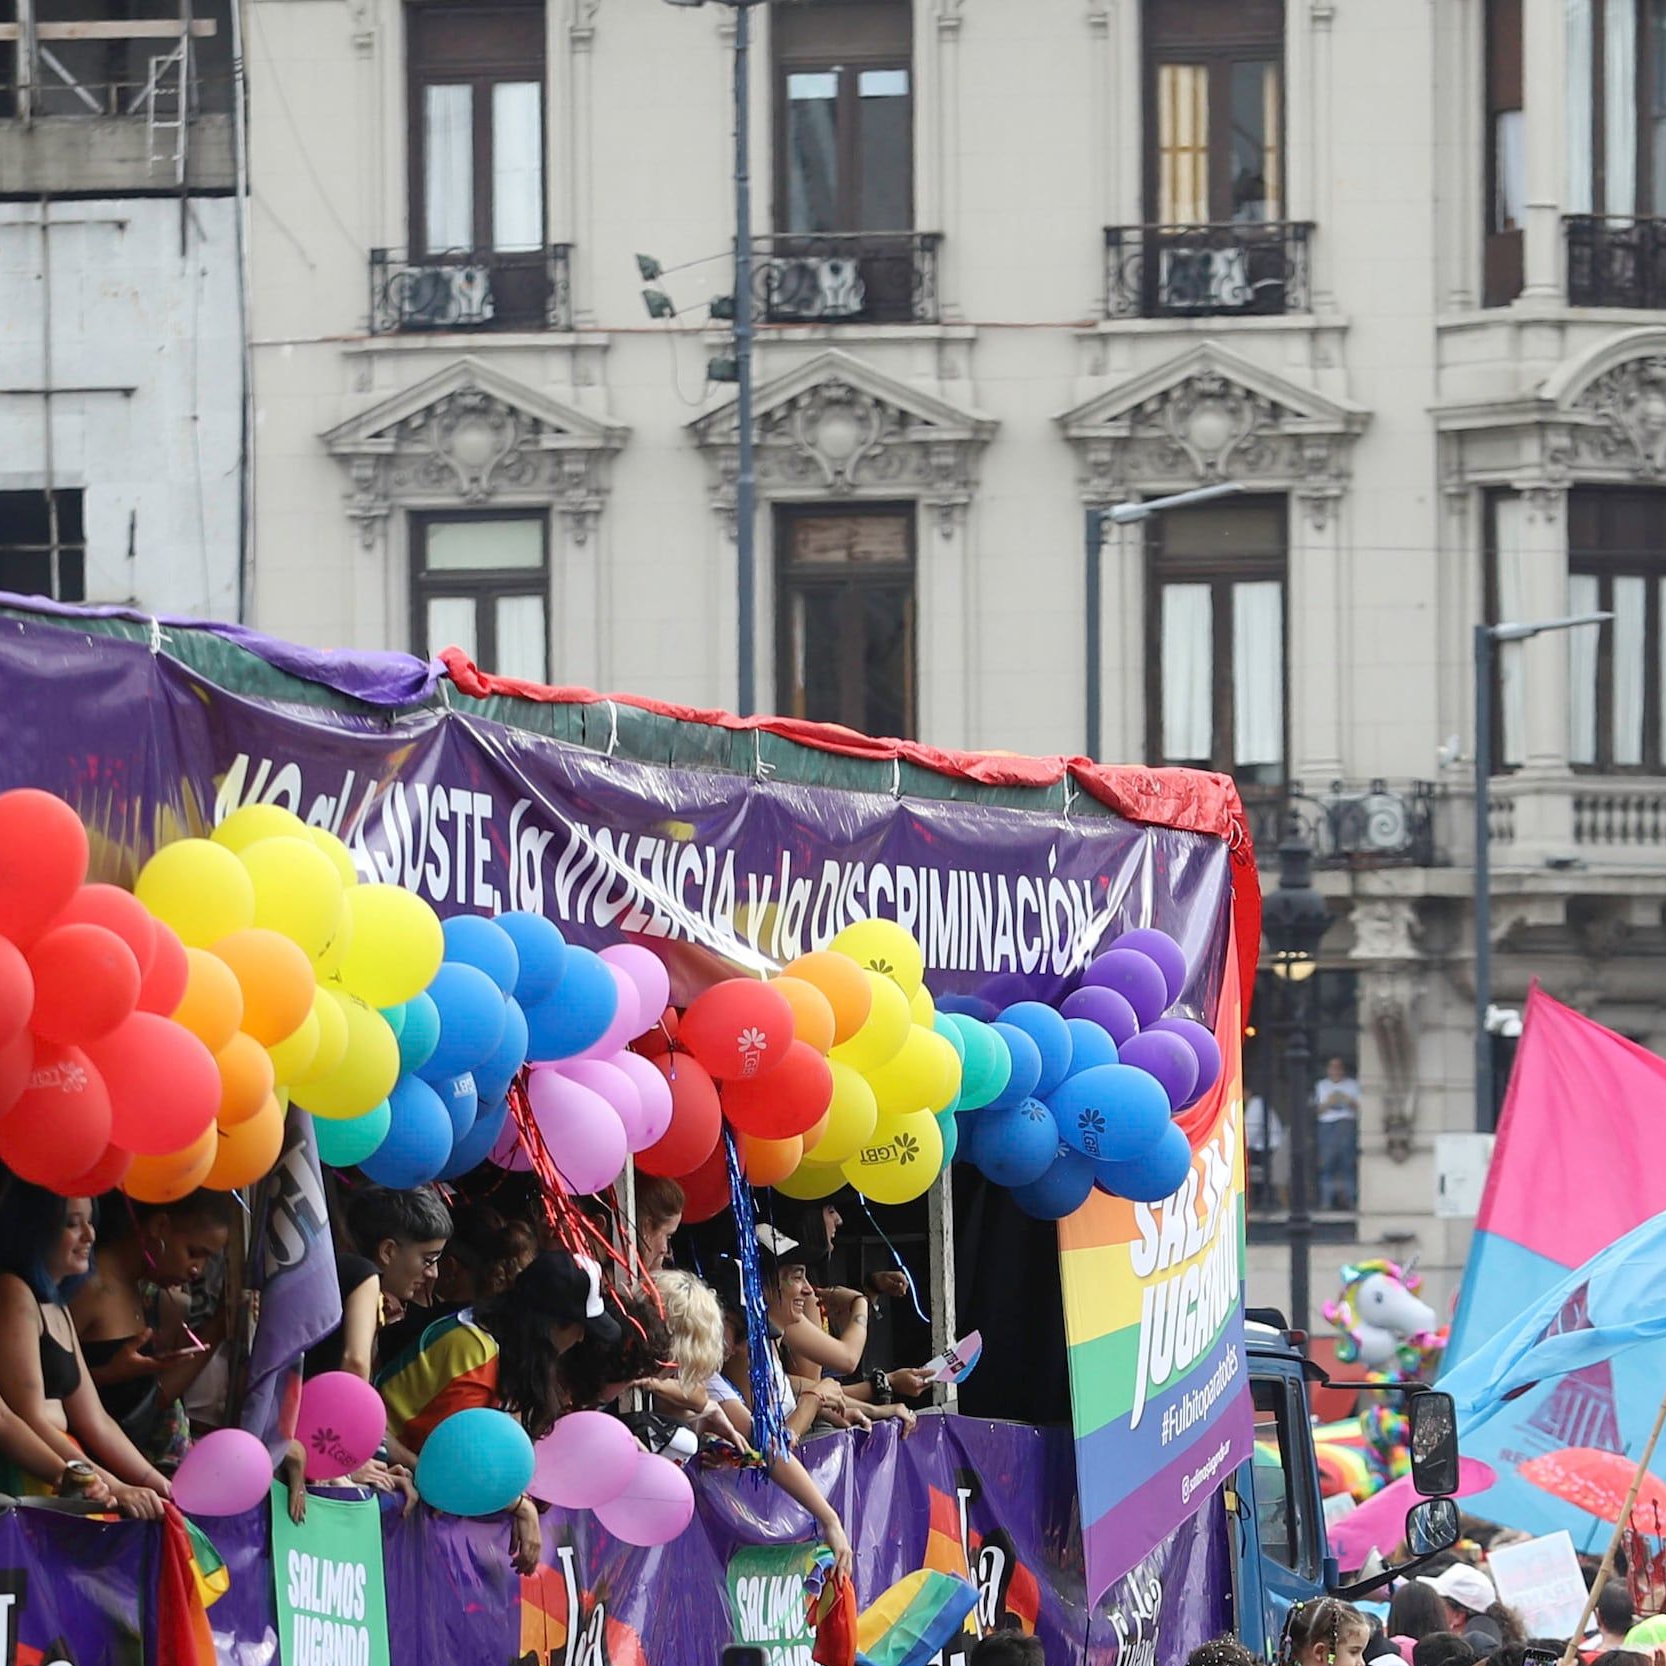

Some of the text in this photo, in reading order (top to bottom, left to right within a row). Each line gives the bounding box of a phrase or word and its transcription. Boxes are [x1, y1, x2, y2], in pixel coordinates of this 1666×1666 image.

[349, 777, 503, 913] AJUSTE,
[509, 798, 556, 915] la
[554, 822, 735, 943] VIOLENCIA
[747, 871, 773, 957] y
[771, 849, 812, 961] la
[812, 844, 1098, 977] DISCRIMINACIÓN
[860, 1144, 898, 1164] LGBT
[1131, 1190, 1240, 1429] JUGANDO
[288, 1549, 367, 1622] SALIMOS
[736, 1574, 817, 1643] SALIMO
